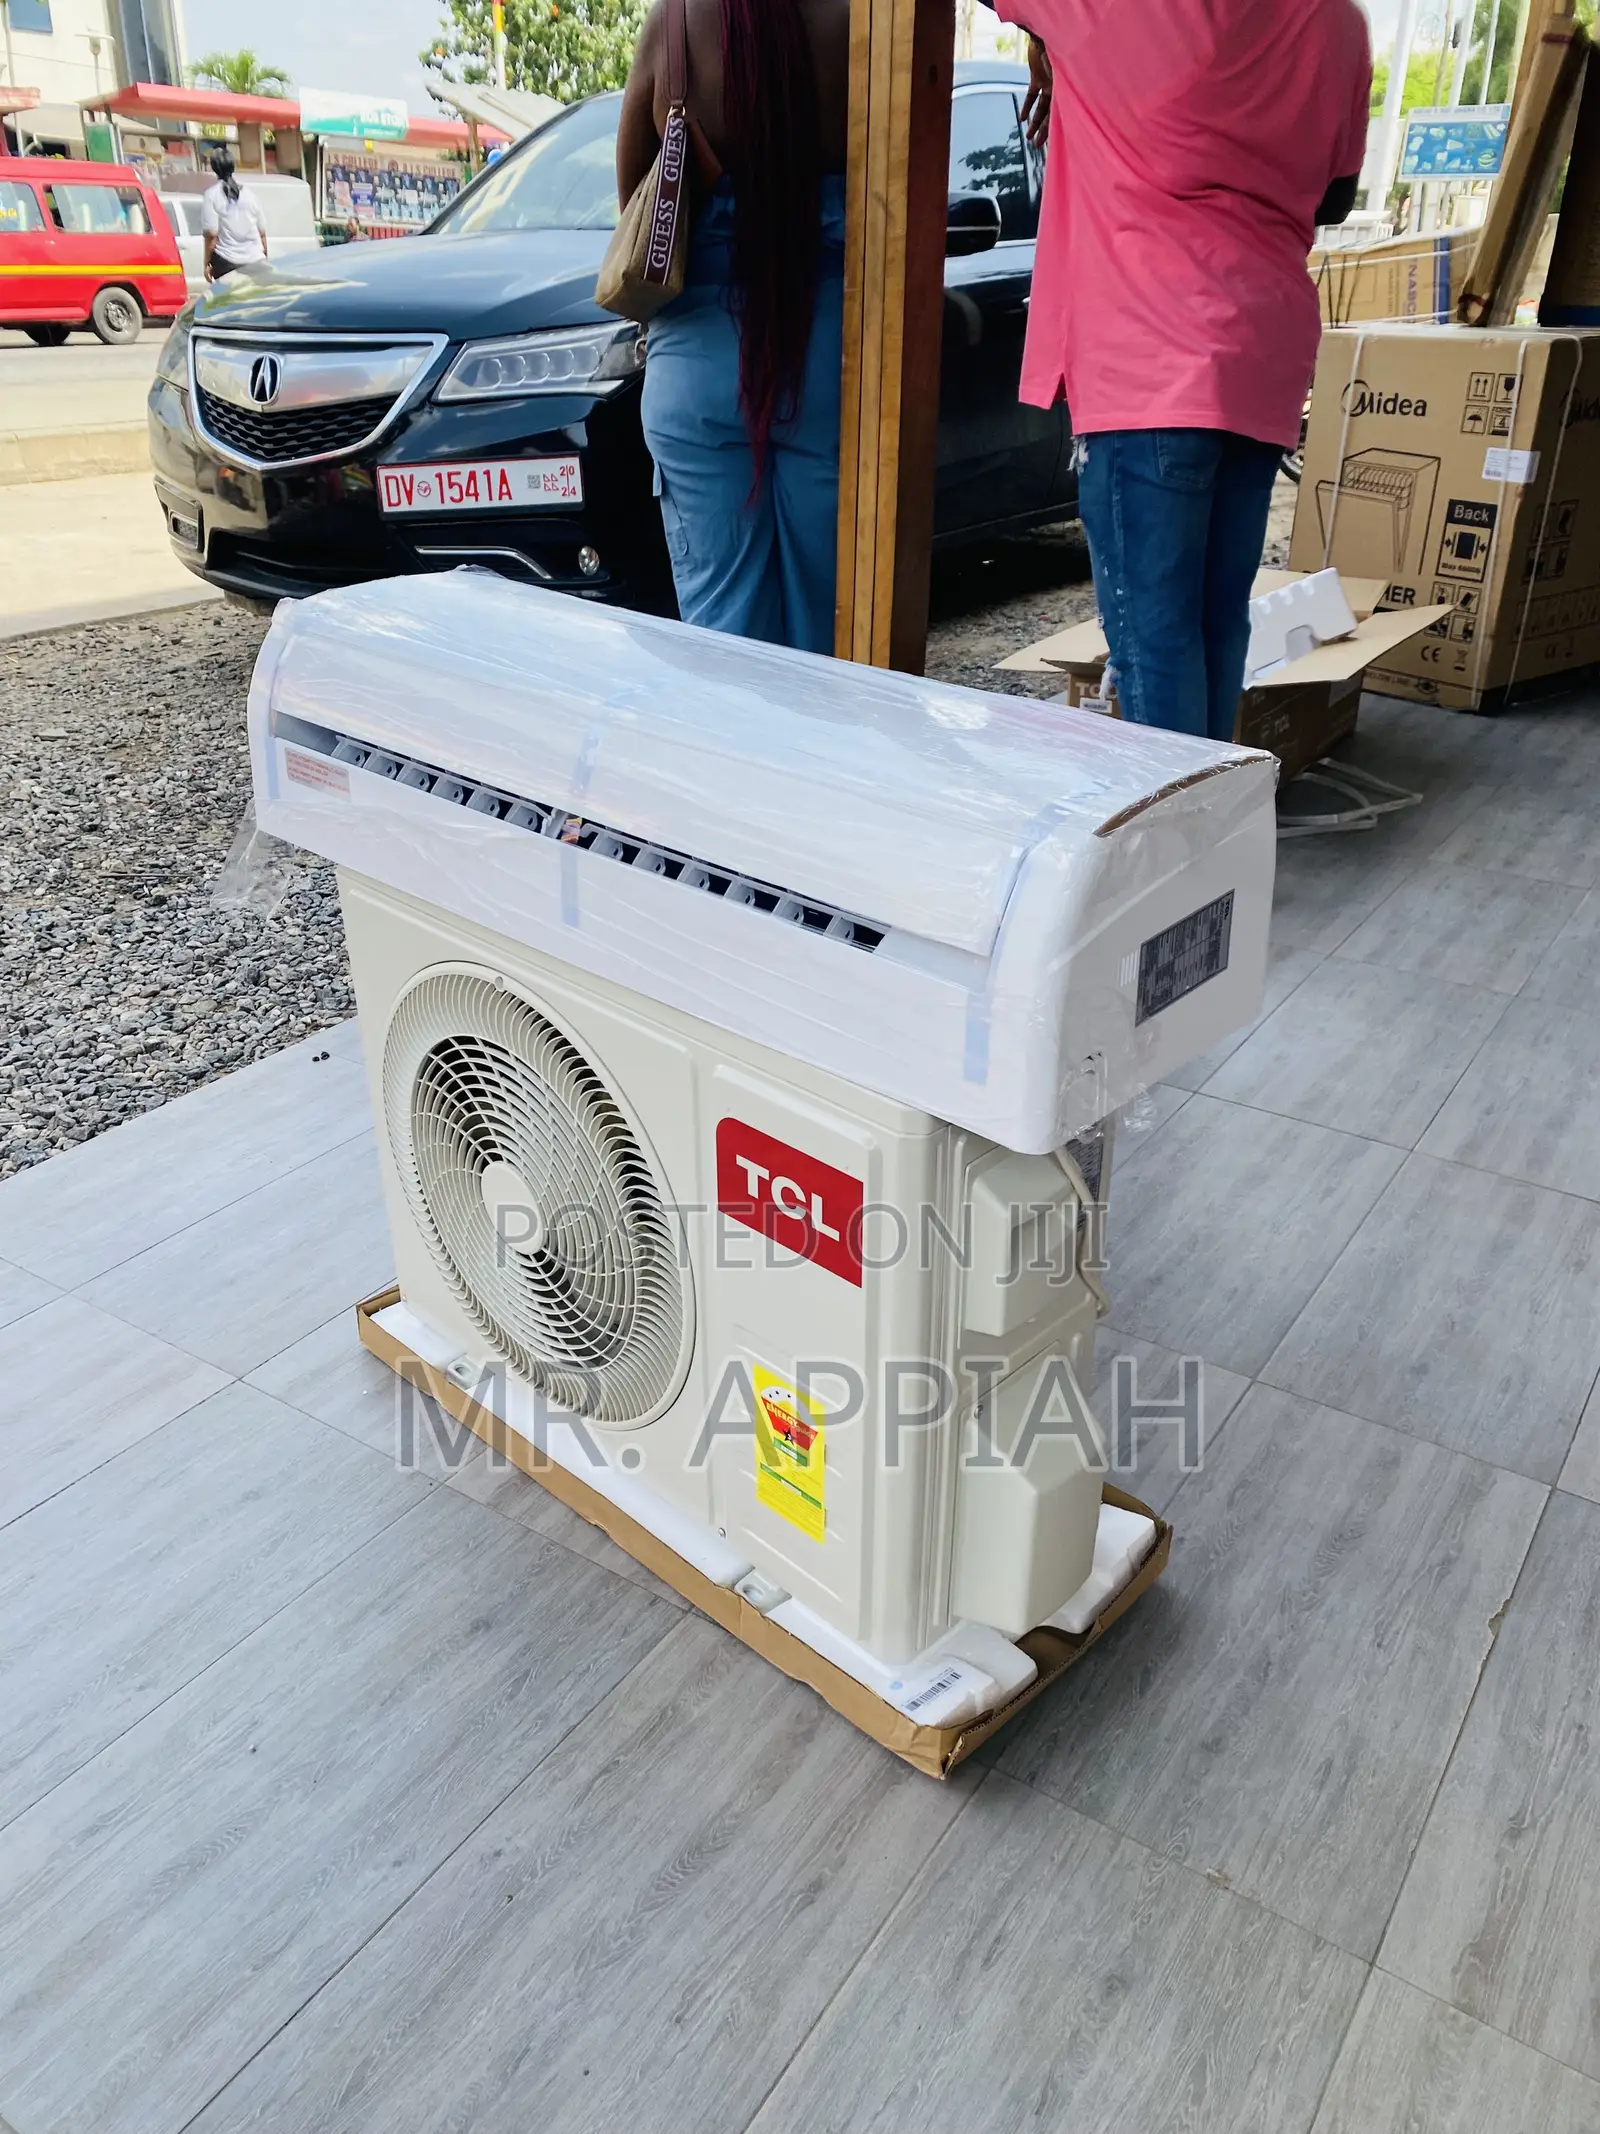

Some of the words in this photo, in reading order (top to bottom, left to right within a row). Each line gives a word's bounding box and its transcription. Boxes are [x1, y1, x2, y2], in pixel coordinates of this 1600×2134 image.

[664, 117, 685, 182] GUESS
[651, 198, 675, 268] GUESS
[1346, 386, 1428, 417] Midea
[384, 474, 415, 508] DV
[435, 468, 513, 505] 1541A
[1454, 504, 1490, 522] Back
[736, 1154, 840, 1242] TCL
[765, 1402, 798, 1429] ENERGY
